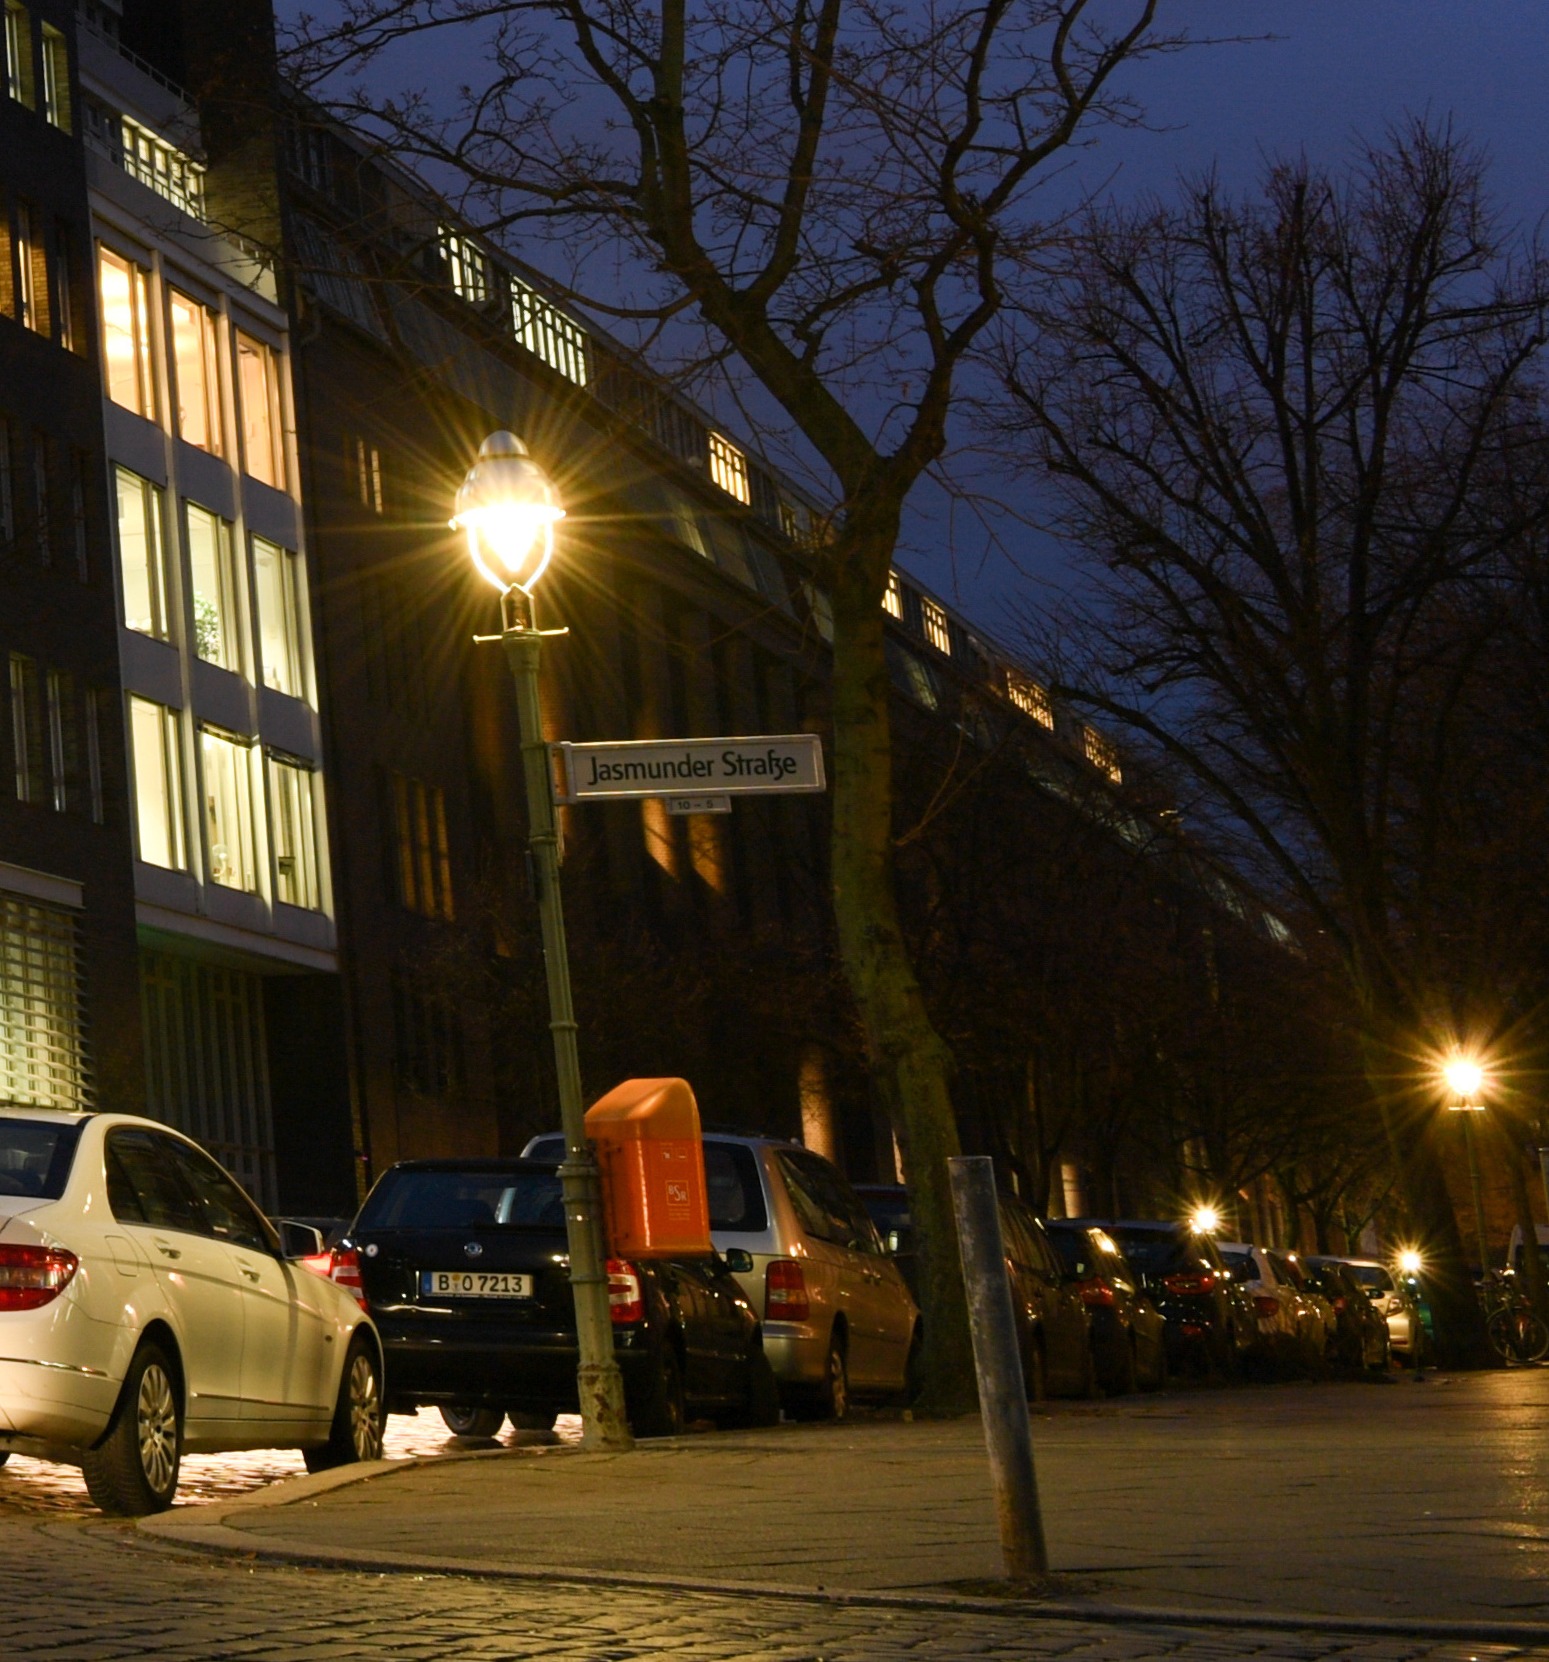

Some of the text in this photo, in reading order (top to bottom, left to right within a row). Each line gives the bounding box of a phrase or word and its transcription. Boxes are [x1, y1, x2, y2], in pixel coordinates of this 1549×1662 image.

[587, 749, 798, 787] Jasmunder Straße
[677, 800, 691, 810] 10
[706, 800, 714, 809] 5
[668, 1184, 688, 1202] BSR
[438, 1274, 450, 1291] B
[478, 1275, 523, 1293] 7213
